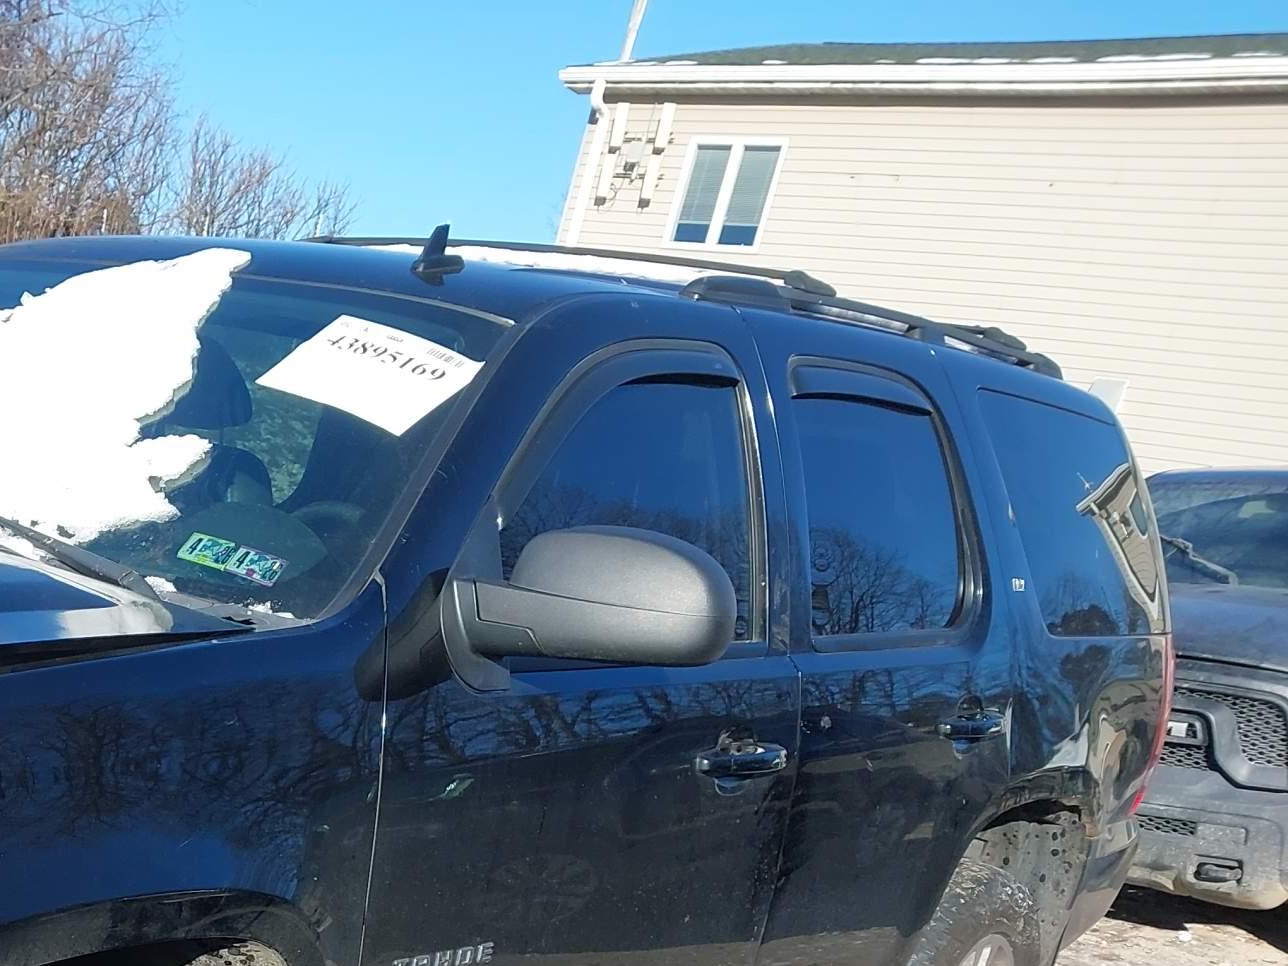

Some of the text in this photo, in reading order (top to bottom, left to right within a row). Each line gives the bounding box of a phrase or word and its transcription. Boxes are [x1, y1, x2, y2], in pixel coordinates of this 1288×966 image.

[327, 334, 447, 382] 43895169
[186, 537, 204, 555] 4
[232, 550, 252, 569] 4
